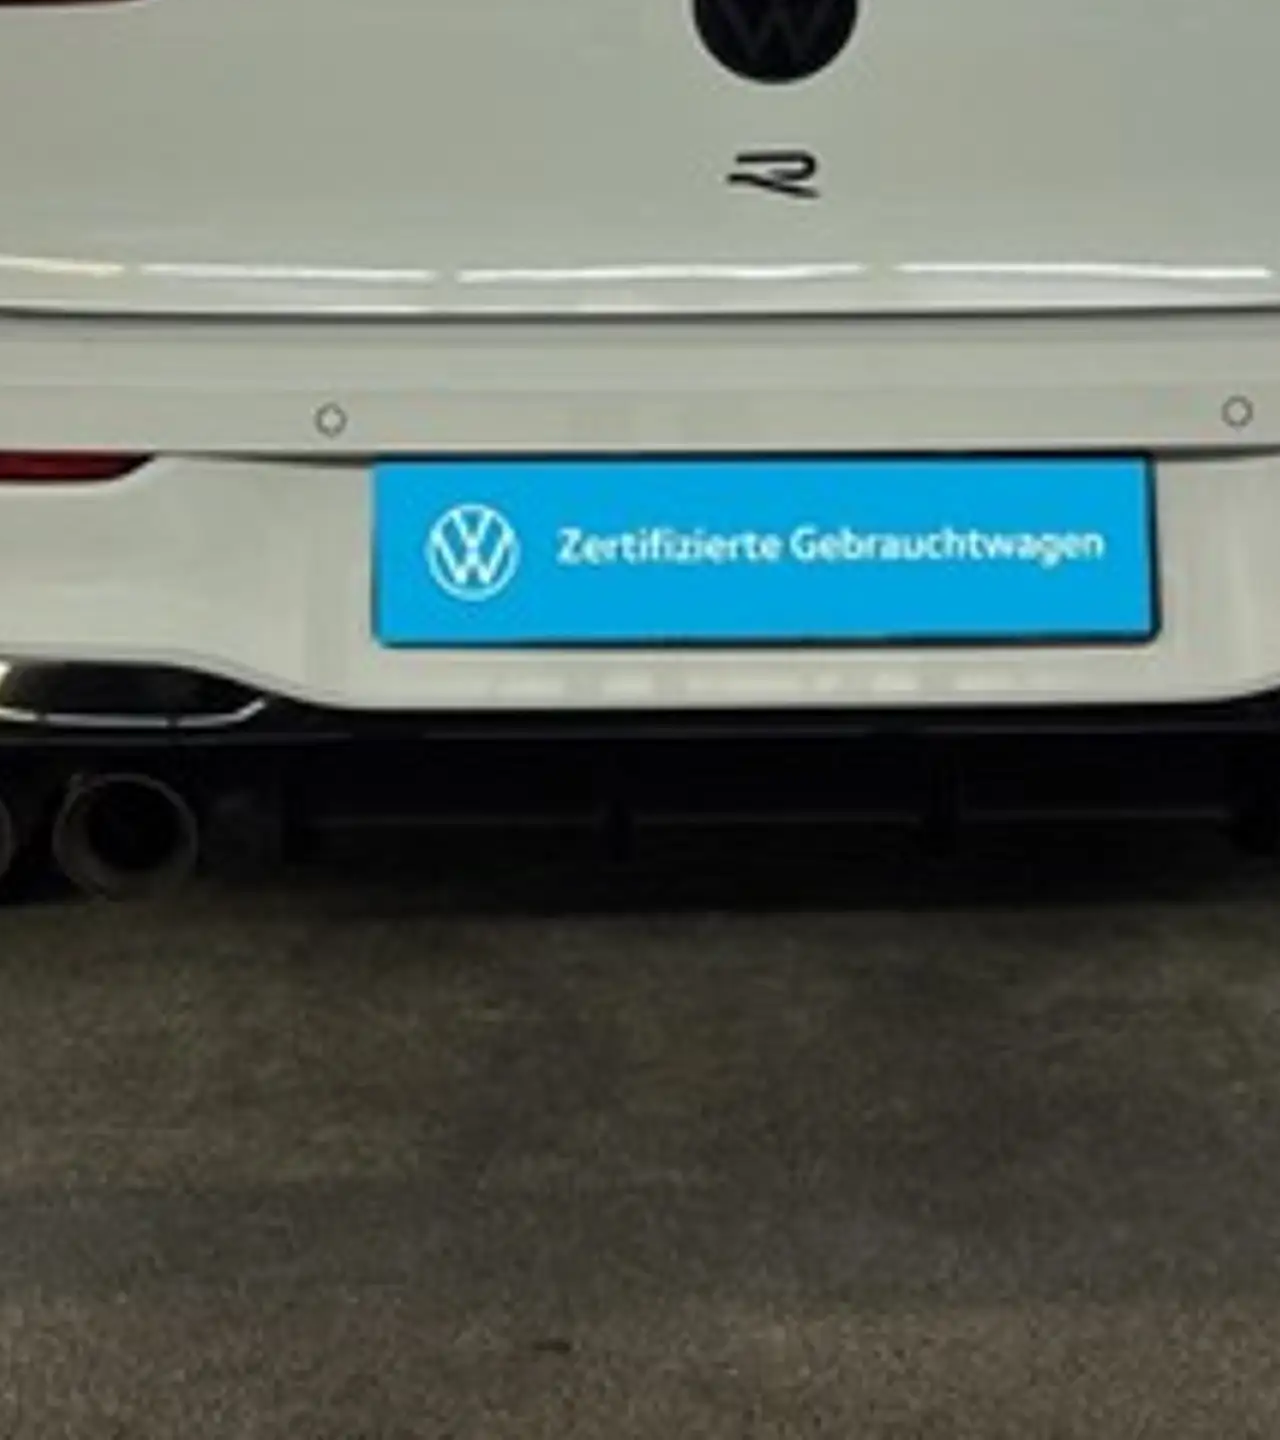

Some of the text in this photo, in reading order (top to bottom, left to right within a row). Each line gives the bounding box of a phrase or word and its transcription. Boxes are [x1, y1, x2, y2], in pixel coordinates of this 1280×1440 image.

[727, 151, 819, 198] R
[427, 506, 1106, 594] VW Zertifizierte Gebrauchtwagen
